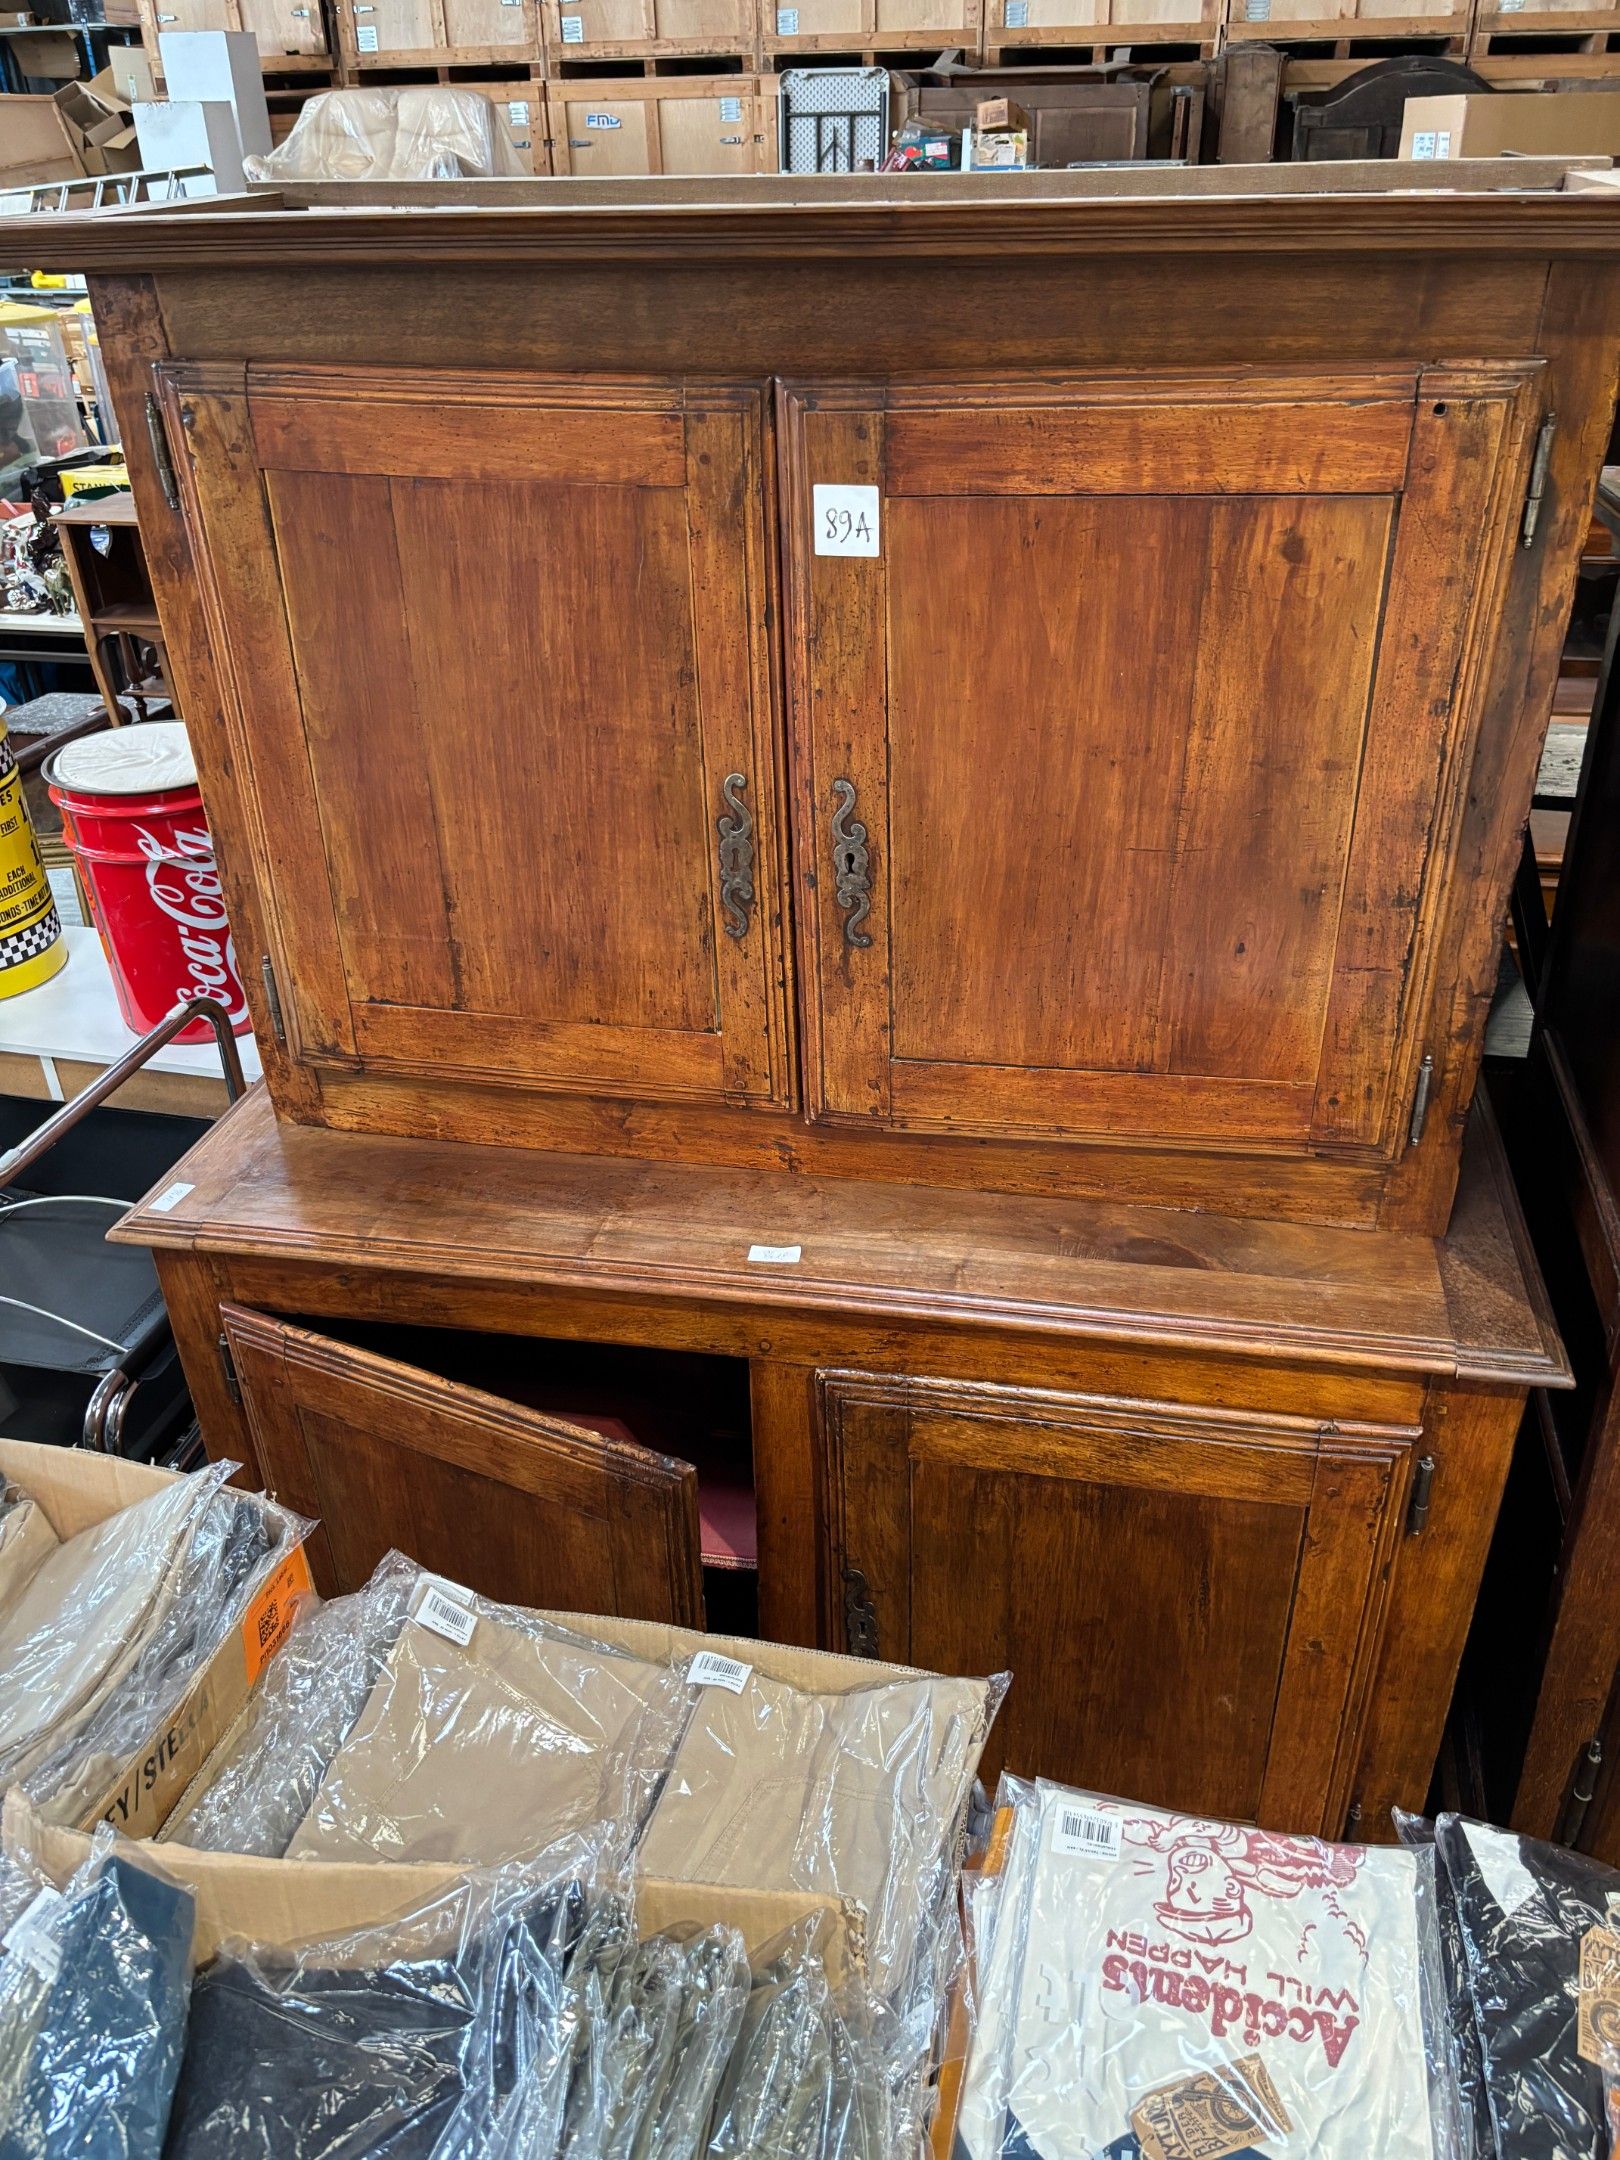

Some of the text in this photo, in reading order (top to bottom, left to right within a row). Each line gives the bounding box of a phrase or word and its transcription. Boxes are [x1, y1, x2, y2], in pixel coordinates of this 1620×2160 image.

[826, 507, 874, 543] 89A
[1, 815, 18, 834] FIRST
[7, 864, 26, 882] EACH
[0, 893, 39, 922] ONDS-TIME
[1106, 1928, 1360, 2012] WILL HAPPEN
[1102, 1954, 1360, 2068] Accidents
